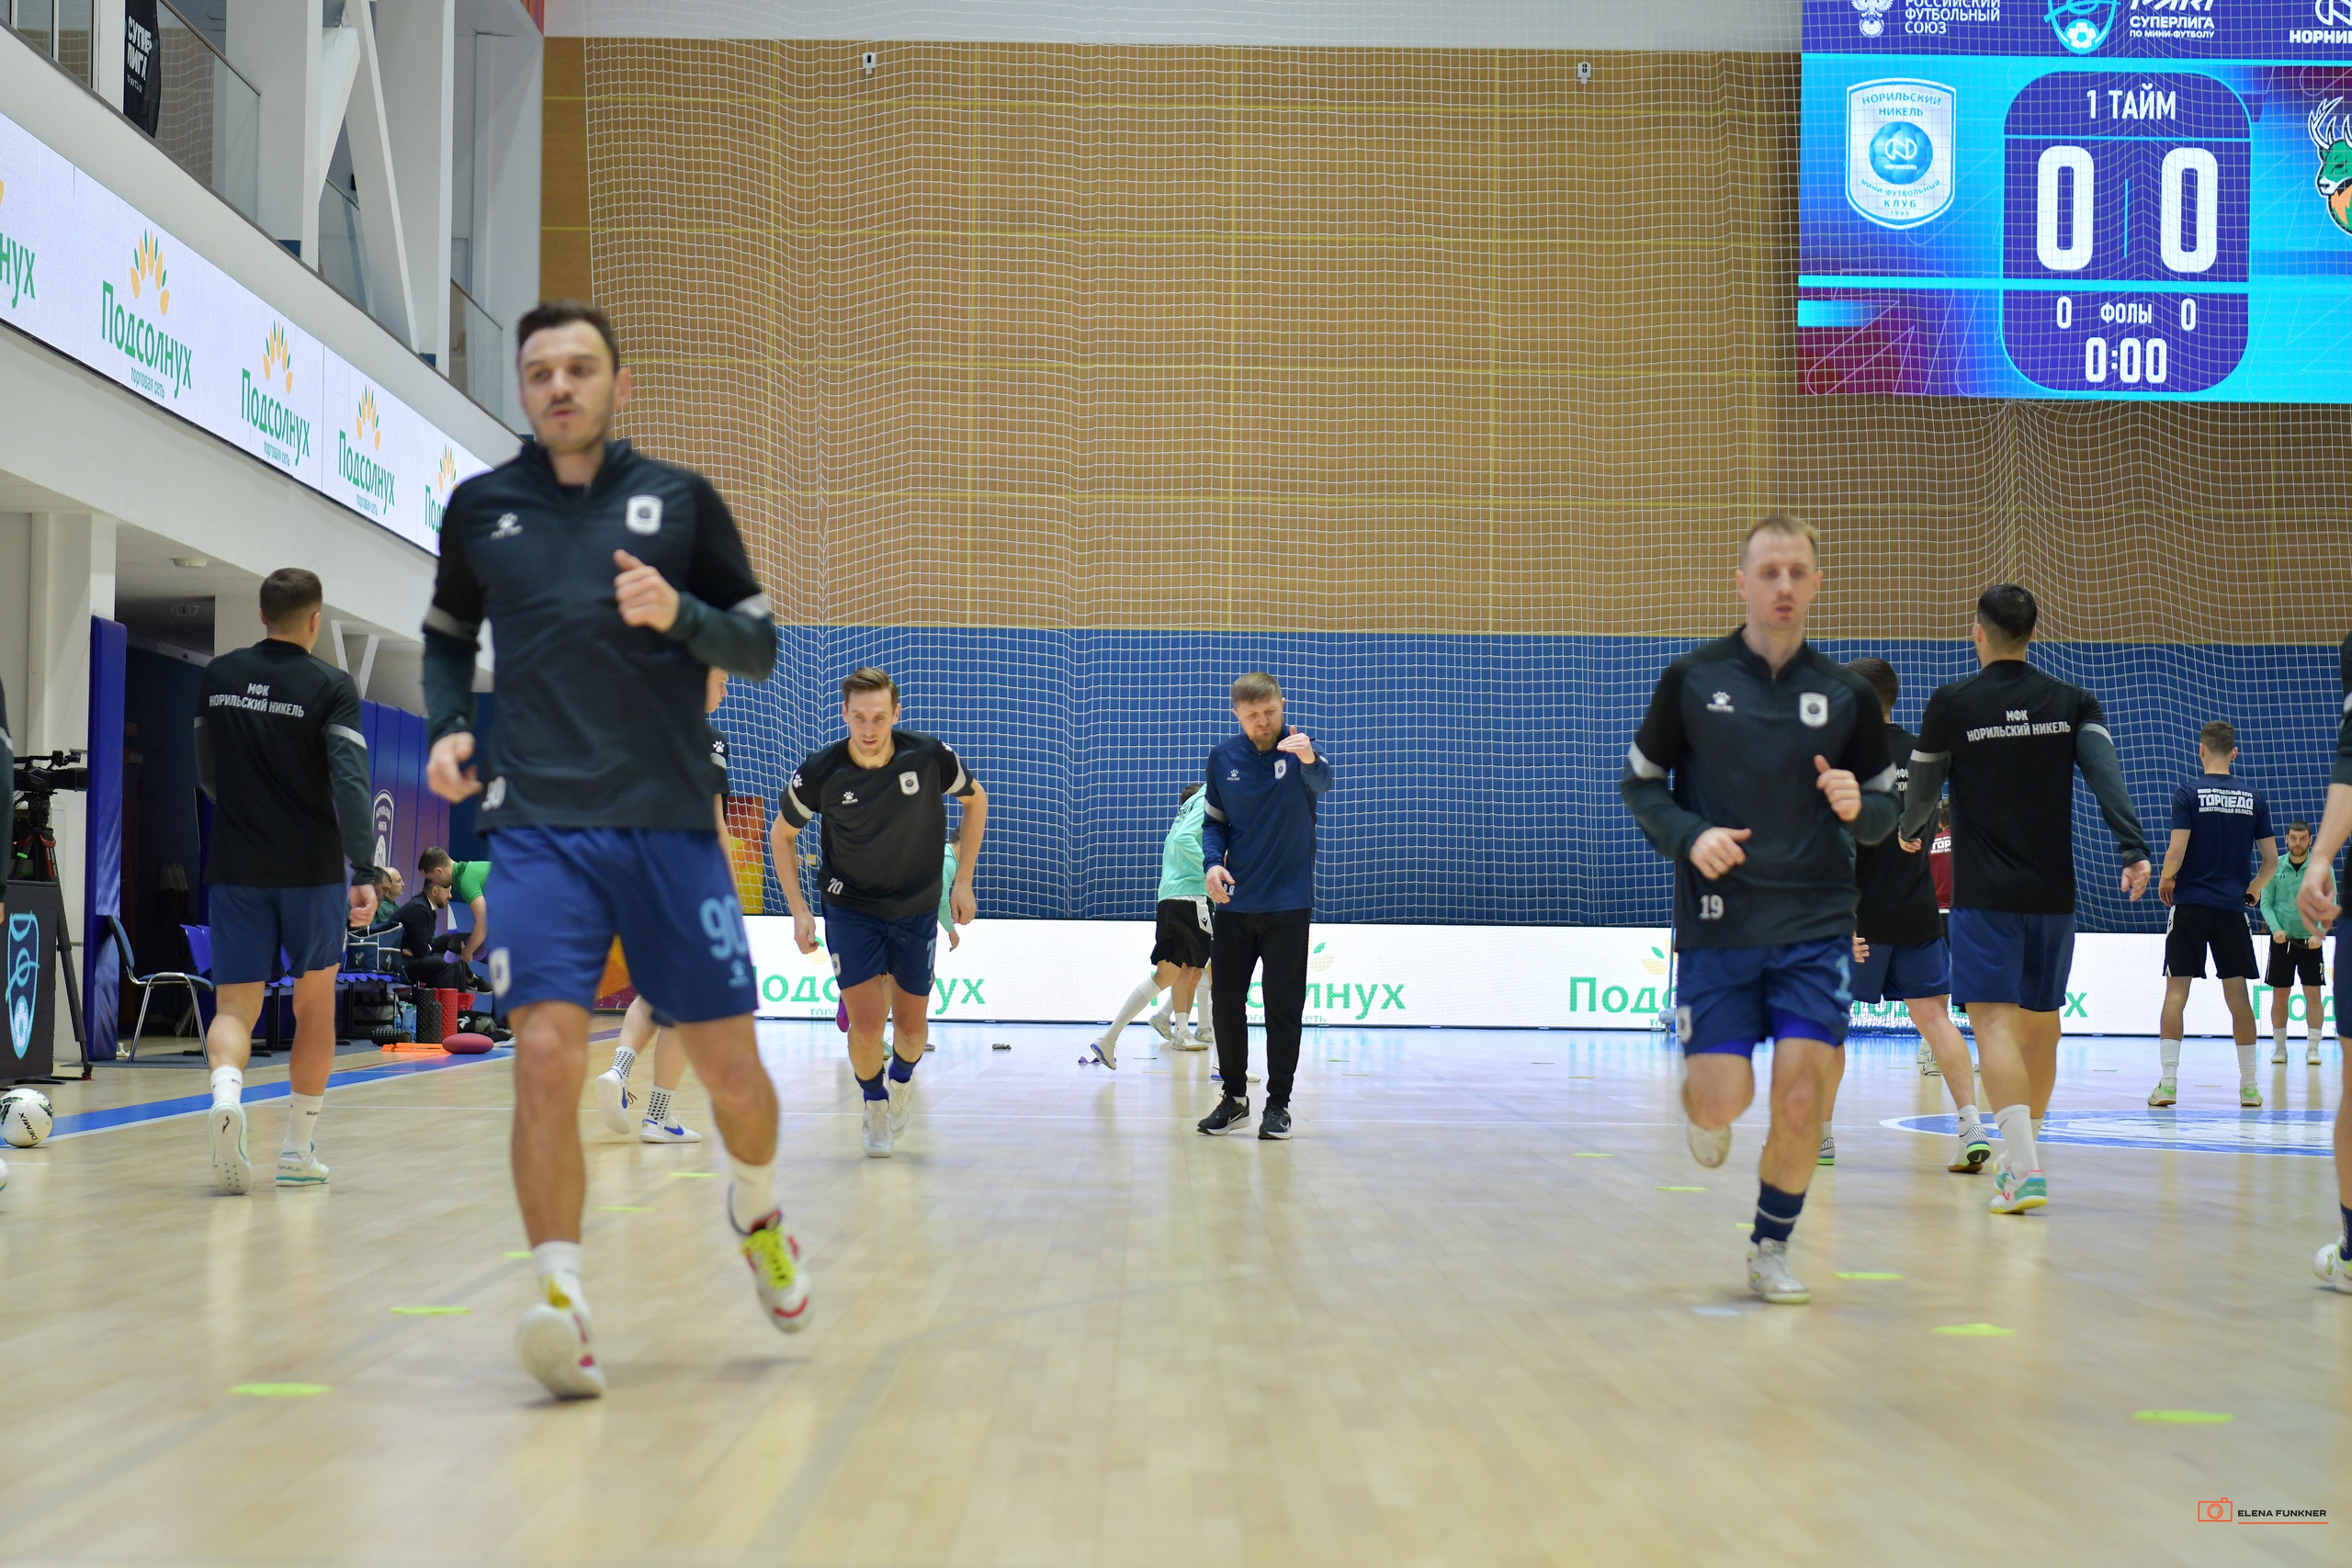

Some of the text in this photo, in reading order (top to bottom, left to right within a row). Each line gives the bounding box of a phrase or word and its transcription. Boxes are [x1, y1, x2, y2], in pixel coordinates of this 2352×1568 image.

[1905, 7, 2000, 21] ФУТБОЛЬНЫЙ
[2130, 16, 2215, 28] СУПЕРЛИГА
[1905, 20, 1947, 34] СОЮЗ
[2144, 30, 2215, 39] МИНИ-ФУТБОЛУ
[2290, 29, 2352, 44] НОРНИ
[1861, 93, 1942, 107] НОРИЛЬСКИЙ
[2086, 83, 2177, 120] 1 ТАЙМ
[1878, 107, 1924, 117] НИКЕЛЬ
[1883, 199, 1917, 208] КЛУБ
[2037, 144, 2219, 273] 0 0
[2056, 296, 2197, 332] 0 ФОЛЫ 0
[101, 279, 193, 400] Подсолнух
[2085, 336, 2167, 383] 0:00
[242, 367, 311, 467] Подсолнух
[338, 428, 395, 515] Подсолнух
[247, 682, 271, 696] МФК
[209, 694, 305, 717] НОРИЛЬСКИЙ НИКЕЛЬ
[2006, 709, 2029, 722] МФК
[1966, 720, 2071, 742] НОРИЛЬСКИЙ НИКЕЛЬ
[2198, 794, 2254, 809] ТОРПЕДО
[827, 877, 843, 895] 70
[1699, 894, 1724, 919] 19
[18, 1111, 39, 1141] DEMIX
